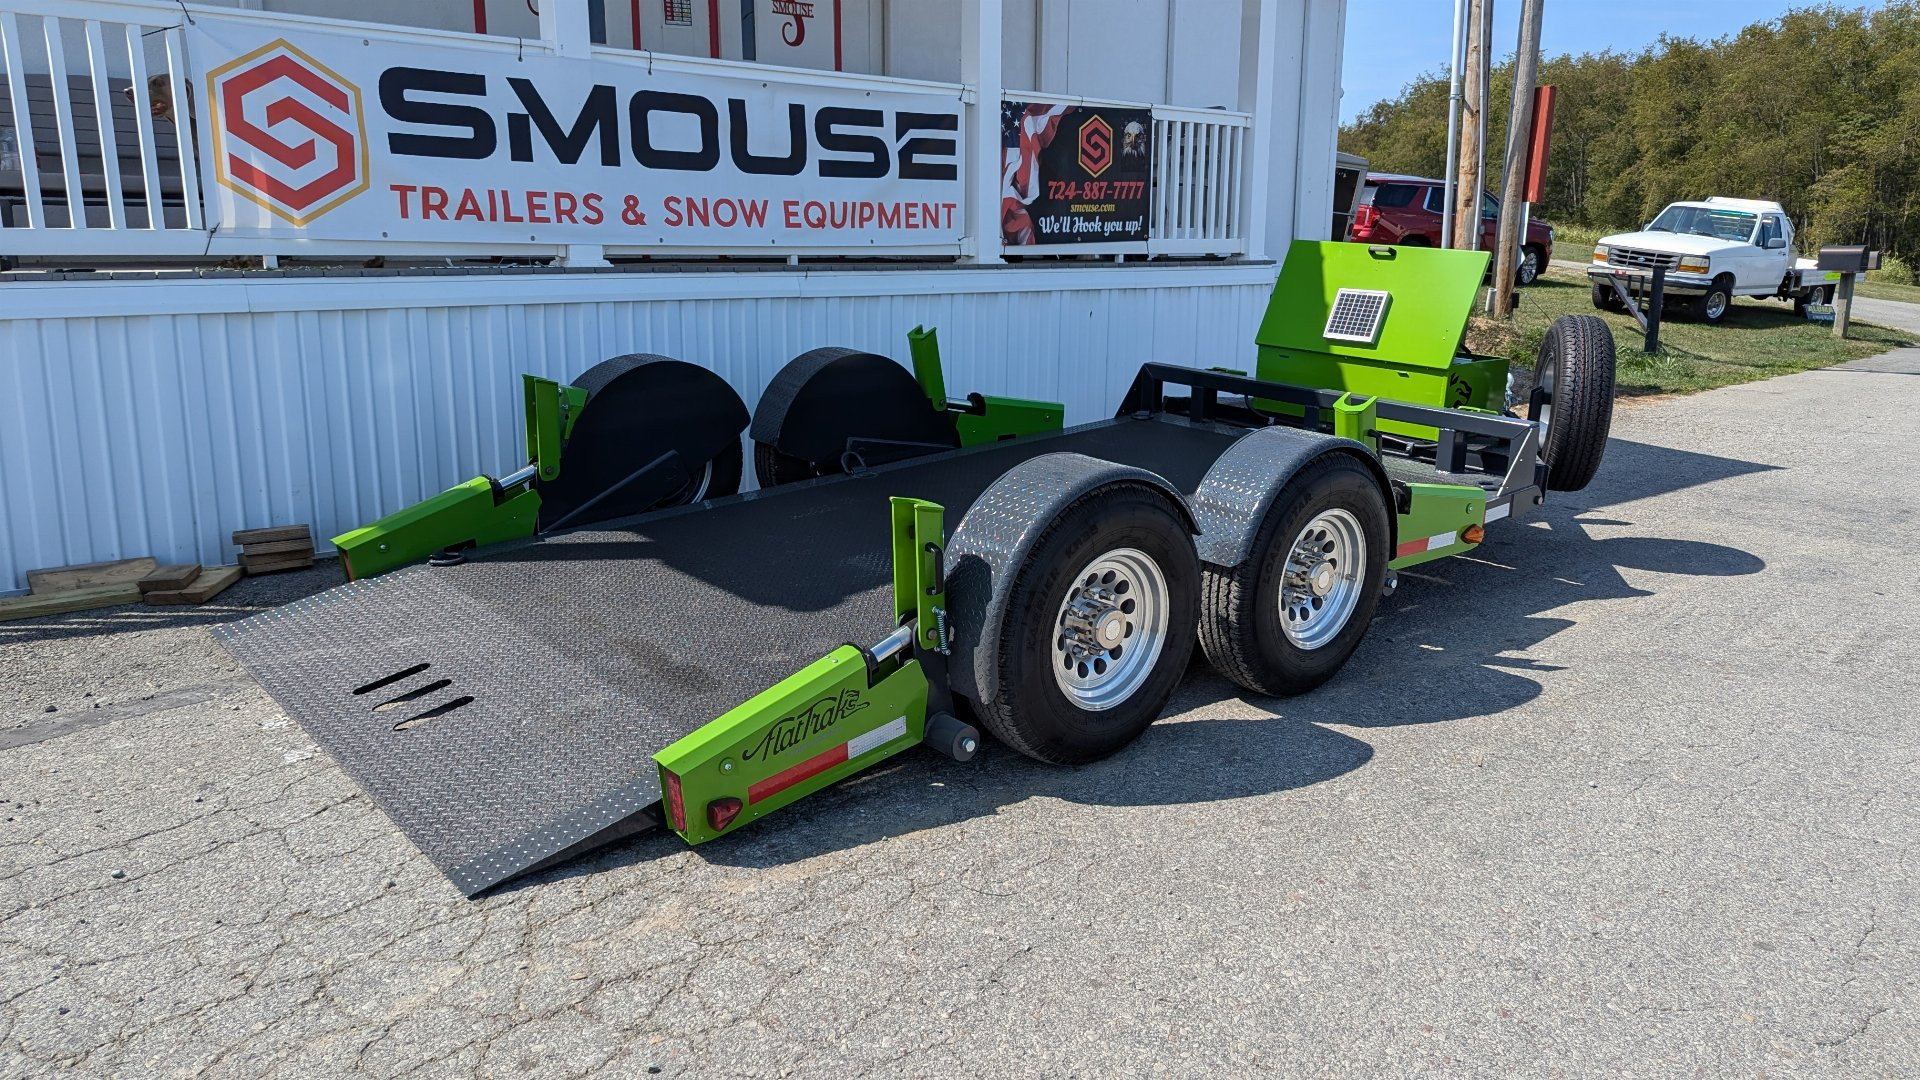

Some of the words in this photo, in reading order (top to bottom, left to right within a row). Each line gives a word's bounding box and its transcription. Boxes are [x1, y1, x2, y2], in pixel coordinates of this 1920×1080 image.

[378, 66, 959, 181] SMOUSE
[1047, 180, 1145, 200] 724-887-7777
[389, 184, 605, 226] TRAILERS
[621, 194, 647, 226] &
[664, 196, 769, 228] SNOW
[783, 200, 958, 230] EQUIPMENT
[1070, 203, 1116, 213] smouse.com
[1039, 215, 1070, 234] We'll
[1072, 216, 1102, 234] Hook
[1103, 221, 1123, 236] you
[1125, 215, 1143, 235] up!
